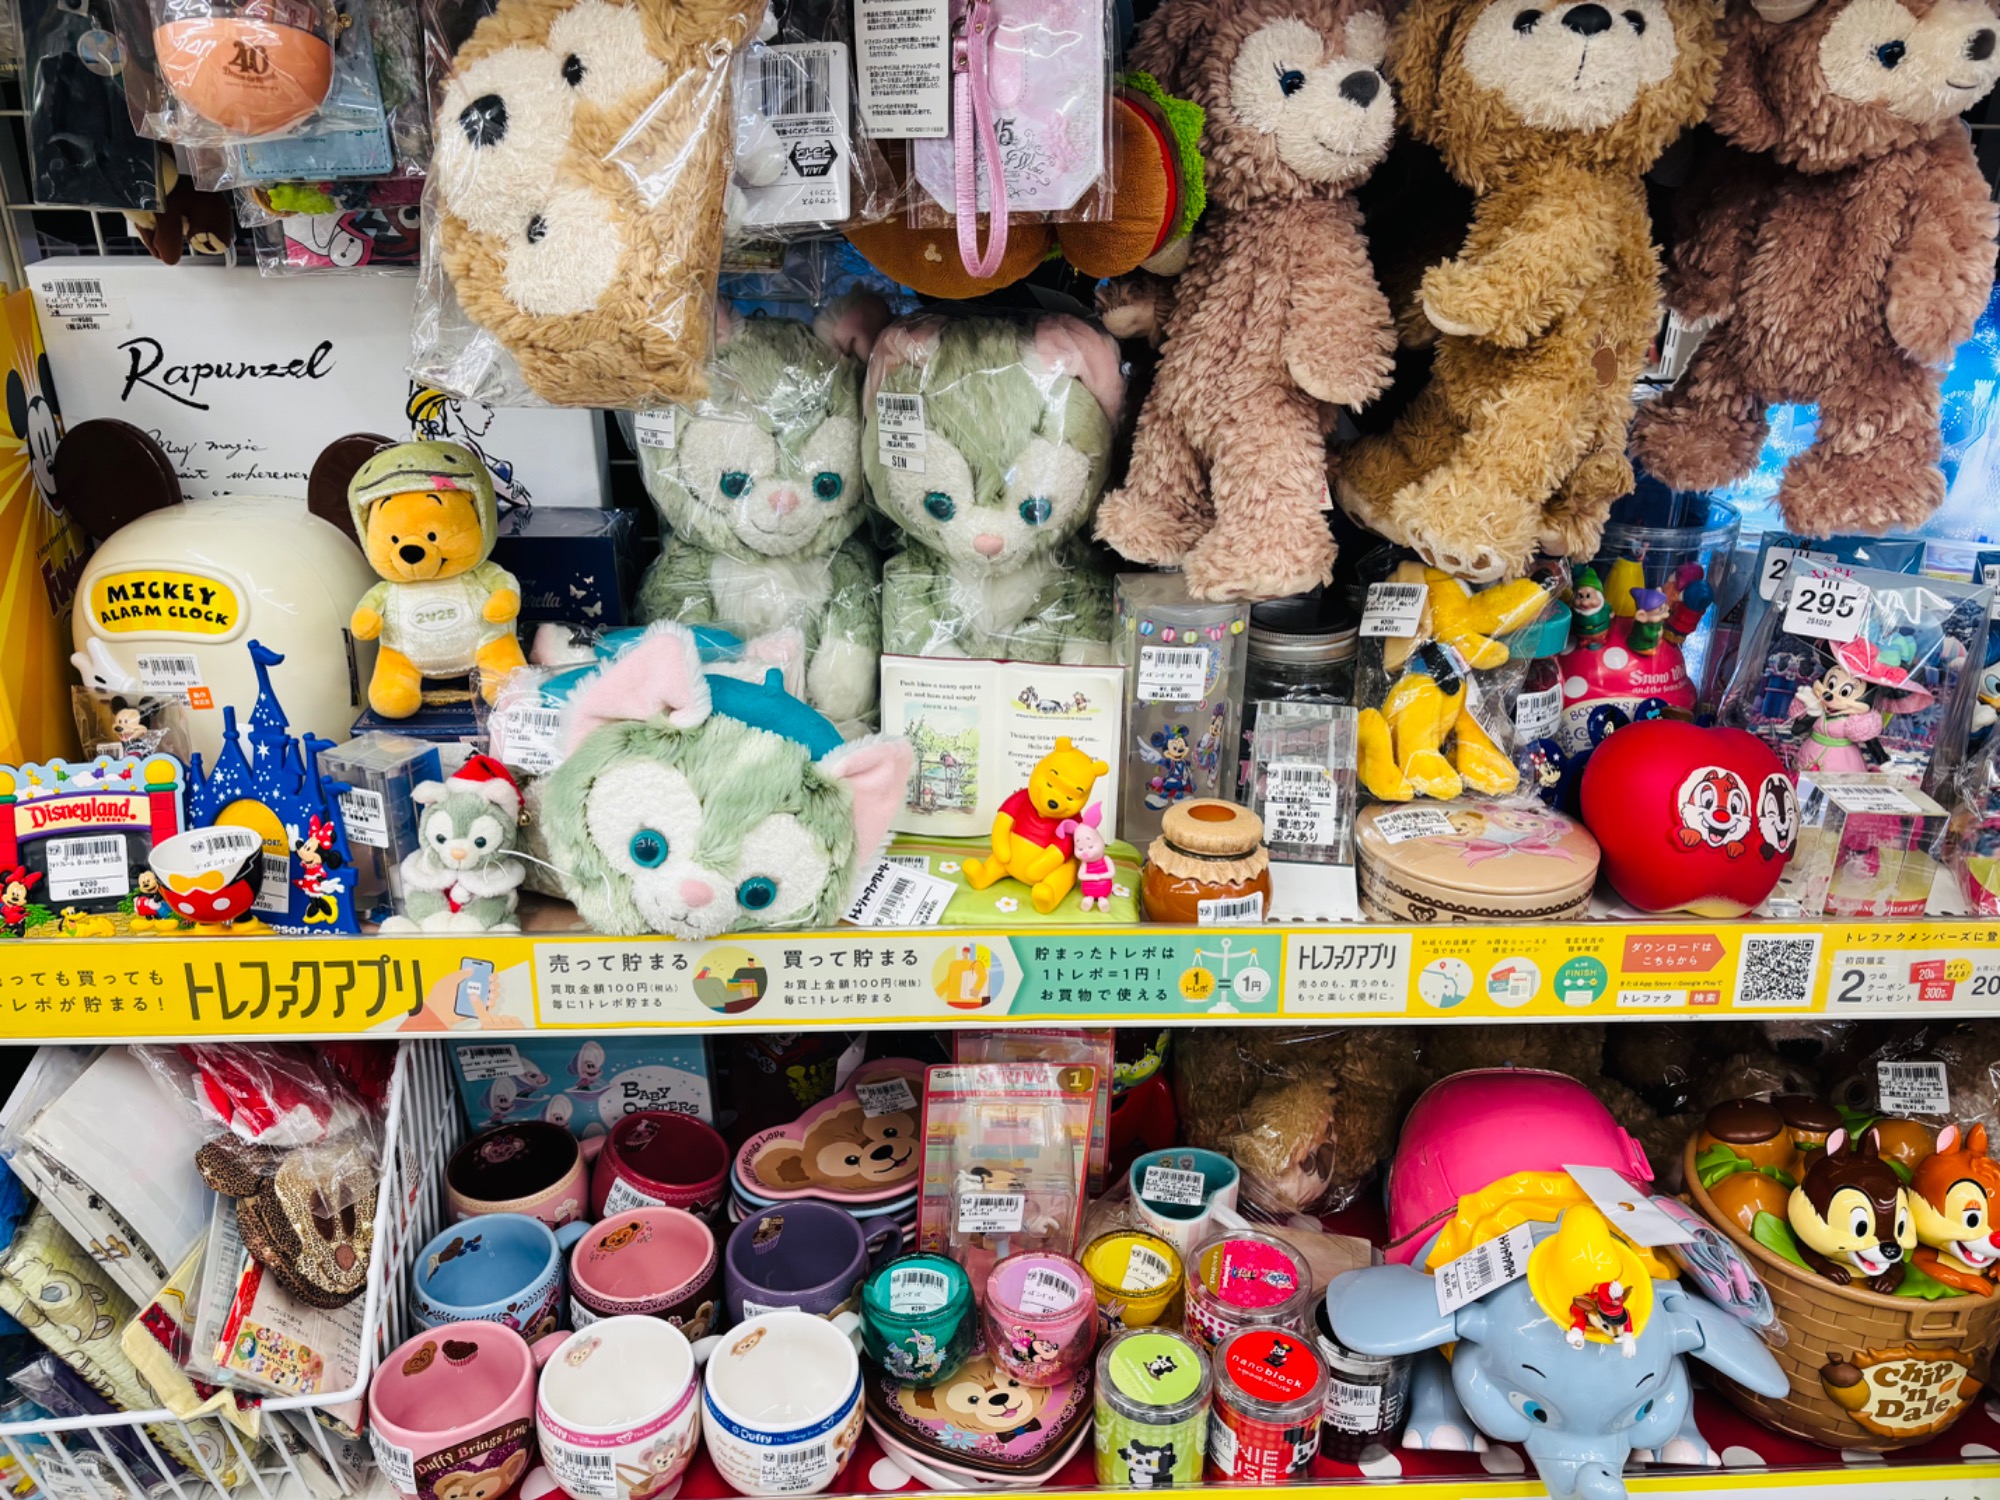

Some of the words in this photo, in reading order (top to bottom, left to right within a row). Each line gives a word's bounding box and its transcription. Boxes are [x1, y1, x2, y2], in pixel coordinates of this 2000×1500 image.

[228, 40, 269, 74] 40
[118, 337, 336, 410] Rapunzel
[206, 439, 266, 459] magic
[176, 468, 209, 479] ait
[107, 581, 216, 605] MICKEY
[1796, 589, 1857, 618] 295
[101, 605, 162, 624] ALARM
[168, 606, 229, 626] CLOCK
[1629, 669, 1668, 686] Snow
[24, 797, 131, 829] Disneyland
[1035, 946, 1175, 961] 貯まったトレポは
[1299, 943, 1396, 970] トレファクアプリ
[1631, 942, 1712, 953] ダウンロードは
[549, 953, 689, 974] 売って貯まる
[784, 949, 918, 969] 買って貯まる
[1642, 956, 1697, 967] こちらから
[0, 970, 163, 987] っても買っても
[1565, 969, 1597, 977] FINISH
[184, 954, 424, 1020] トレファクアプリ
[1242, 975, 1261, 992] 1円
[1837, 970, 1865, 1002] 2
[1868, 983, 1906, 991] クーポン
[0, 996, 165, 1013] レポが貯まる！
[1040, 988, 1168, 1002] お買物で使える
[1622, 993, 1672, 1003] トレファク
[977, 1069, 1048, 1085] SPRING
[1069, 1071, 1082, 1087] 1
[1873, 1362, 1953, 1388] Chip
[1875, 1395, 1950, 1422] Dale
[741, 1428, 772, 1443] Duffy
[416, 1452, 454, 1474] Duffy
[458, 1434, 503, 1458] Brings
